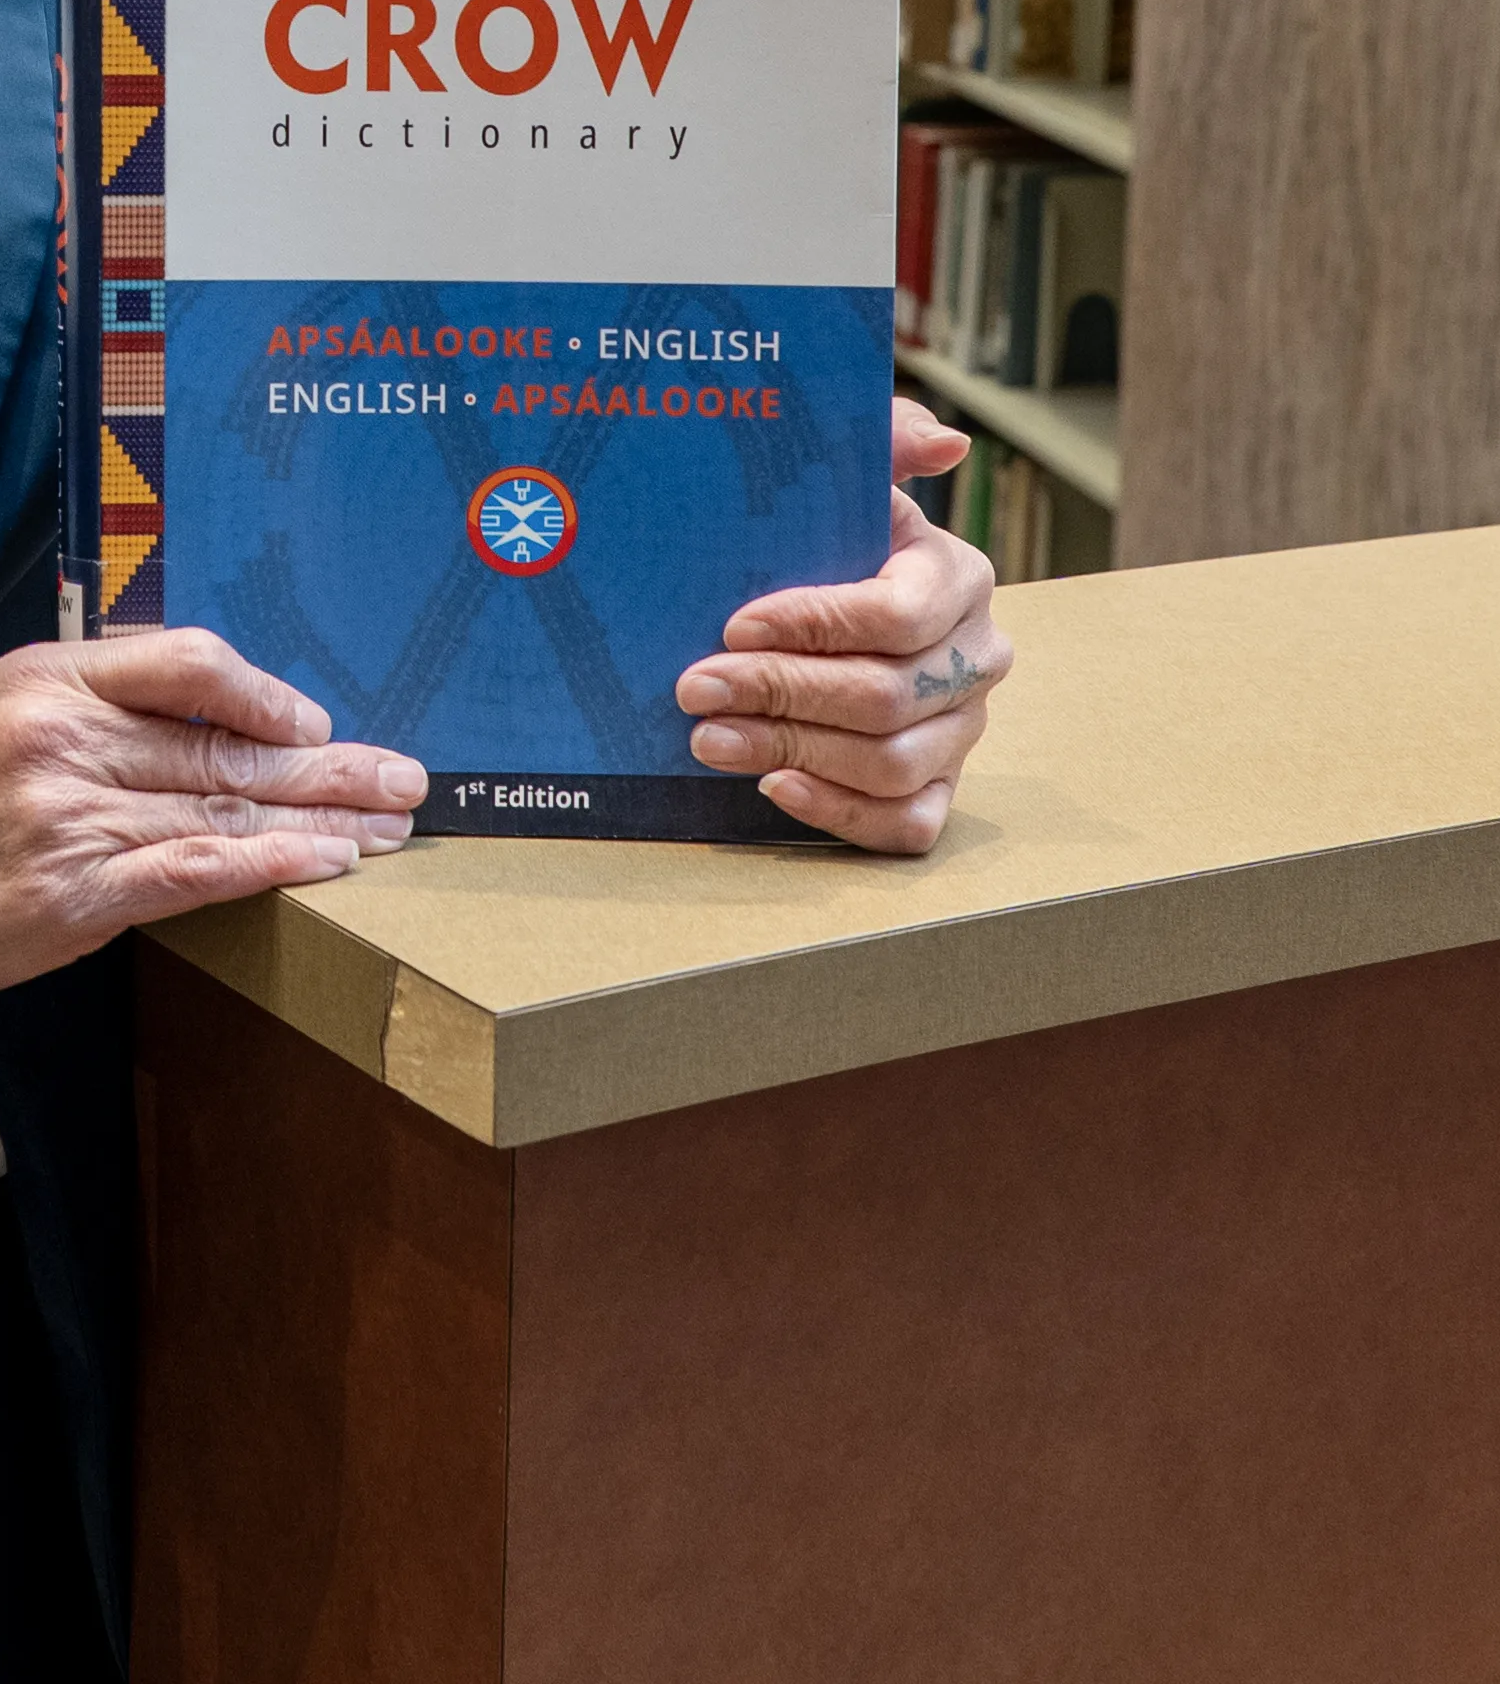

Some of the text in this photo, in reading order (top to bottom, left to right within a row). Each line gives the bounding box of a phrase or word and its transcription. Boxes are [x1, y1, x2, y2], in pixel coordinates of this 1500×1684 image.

[271, 113, 688, 161] dictionary
[265, 317, 781, 363] APSÁALOOKE ENGLISH
[267, 376, 782, 419] ENGLISH APSÁALOOKE
[453, 779, 591, 810] 1st Edition
